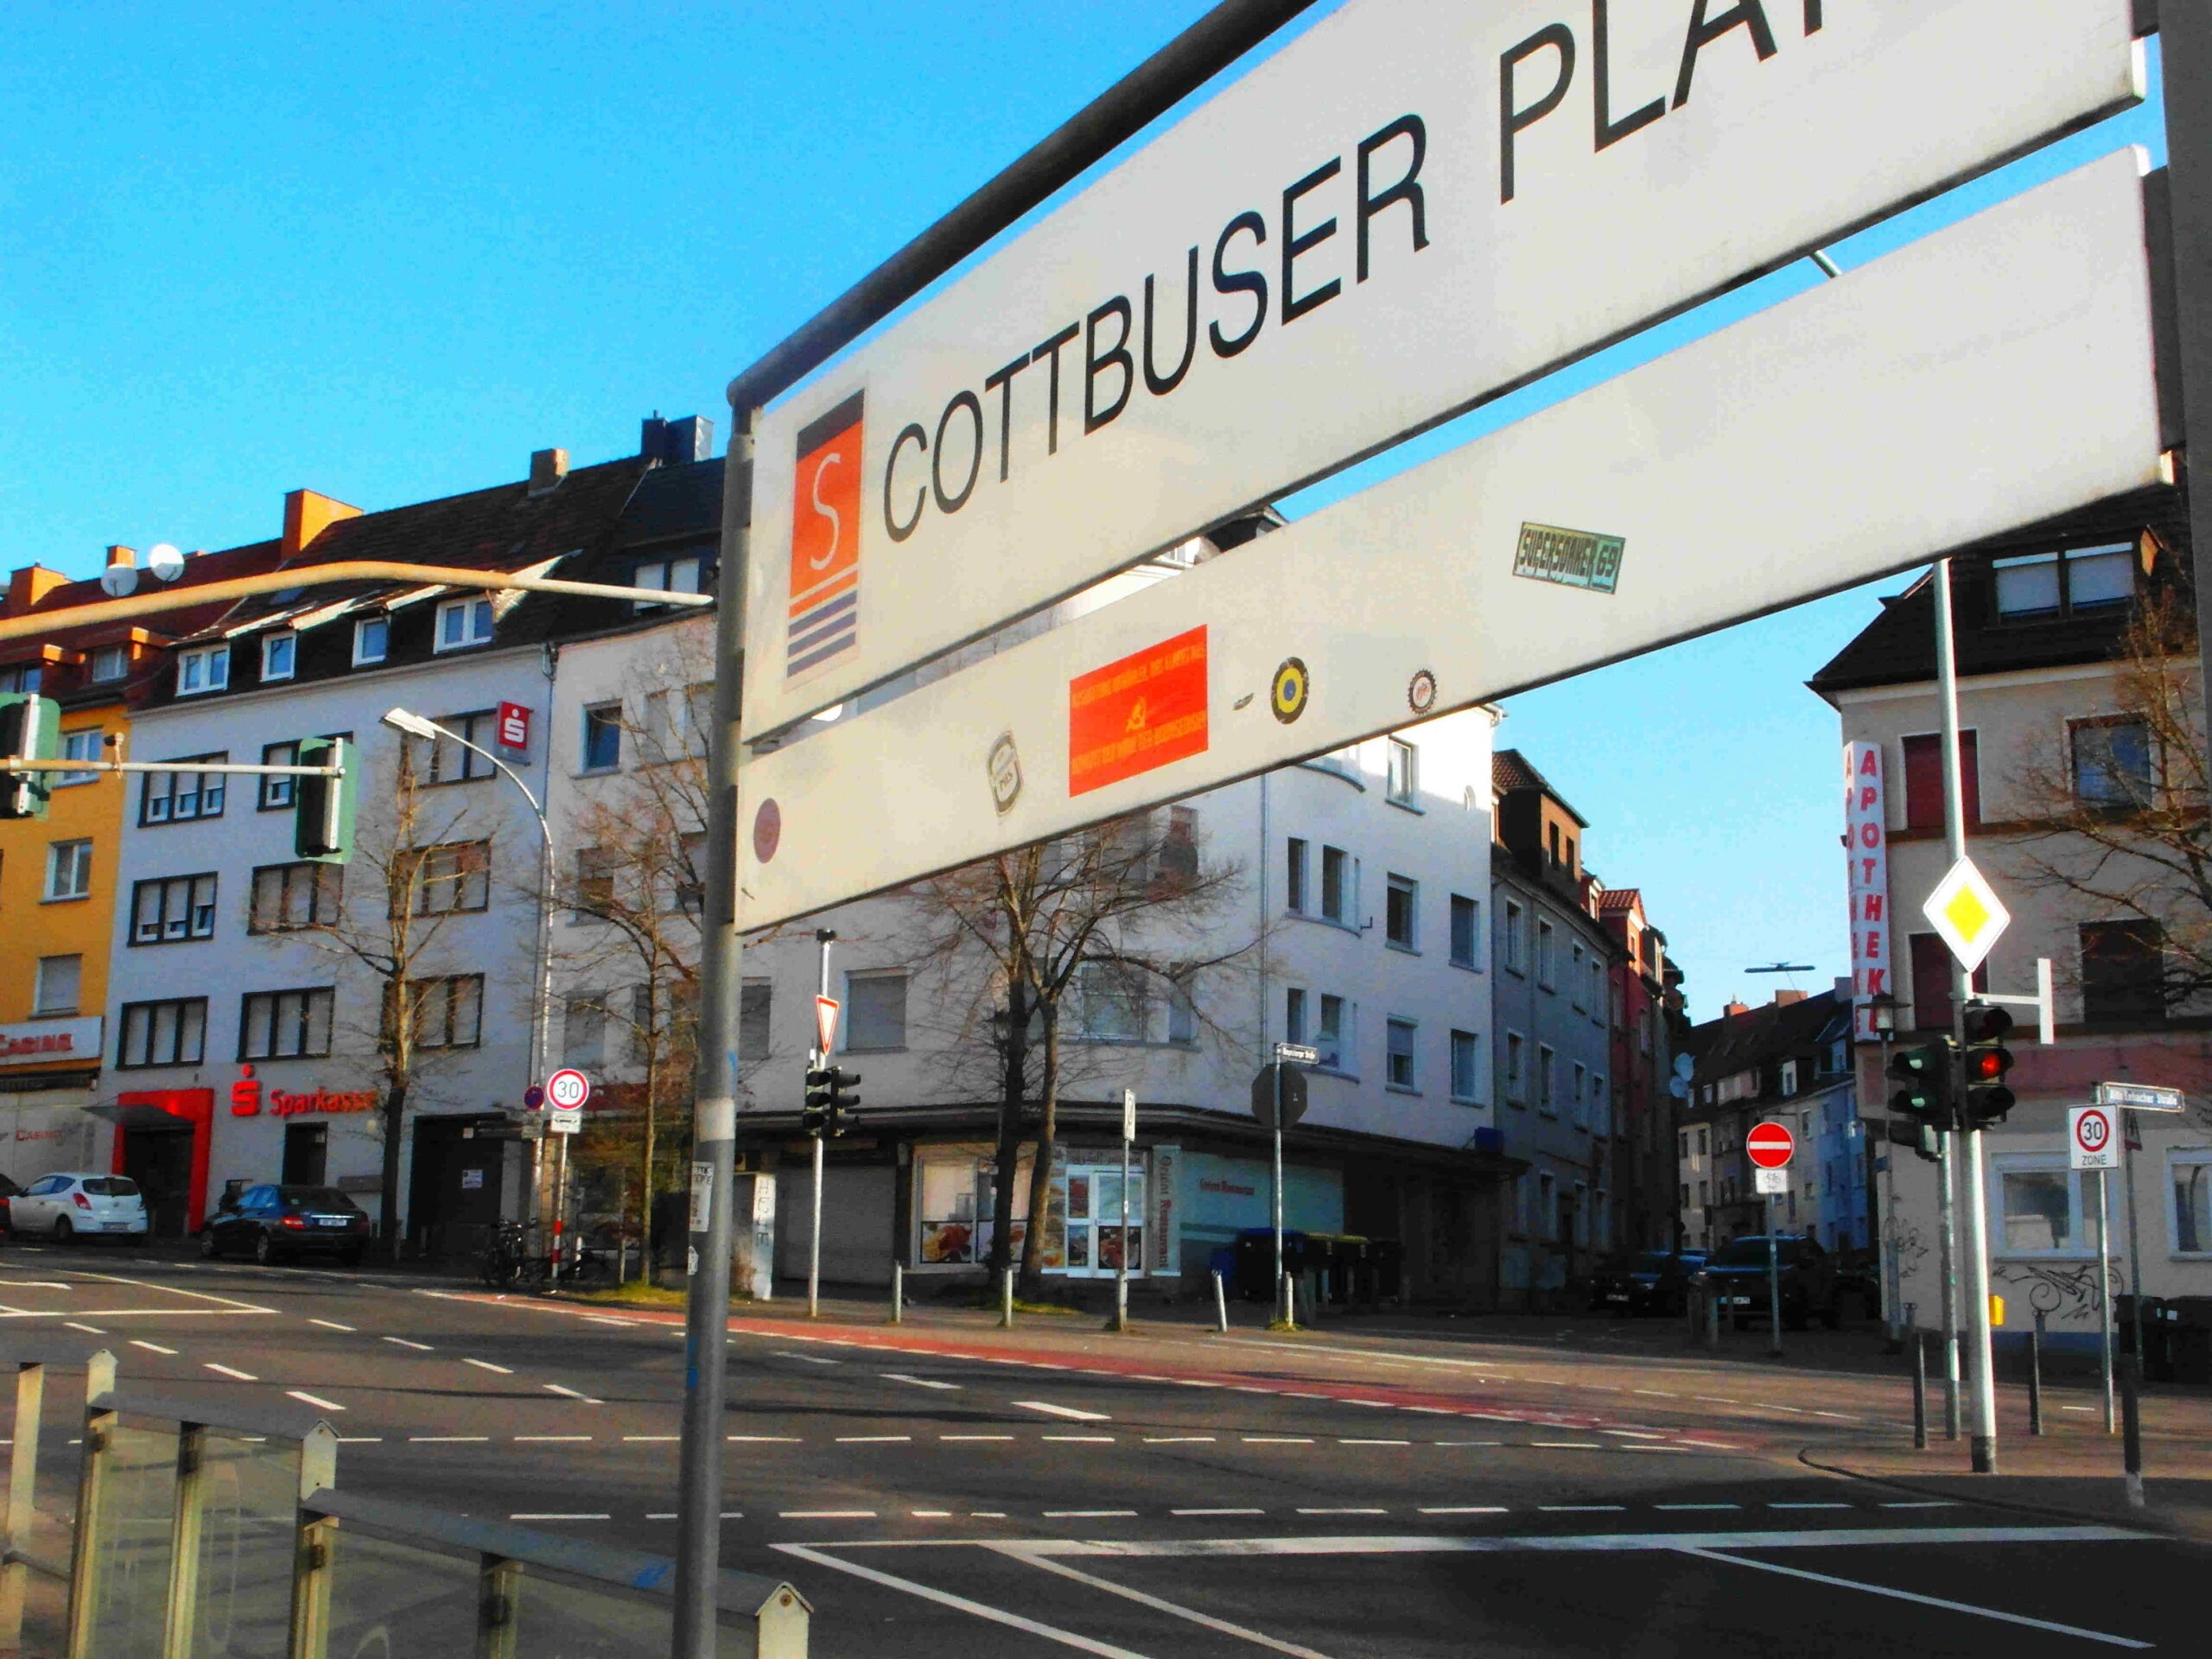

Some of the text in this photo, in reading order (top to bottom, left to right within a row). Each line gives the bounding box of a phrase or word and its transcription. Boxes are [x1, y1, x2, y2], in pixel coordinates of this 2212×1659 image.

[884, 0, 1823, 543] COTTBUSER PLA
[1596, 544, 1619, 577] 69
[269, 1086, 378, 1119] Sparkasse
[557, 1081, 580, 1099] 30
[2083, 1122, 2102, 1141] 30
[2082, 1154, 2107, 1166] ZONE
